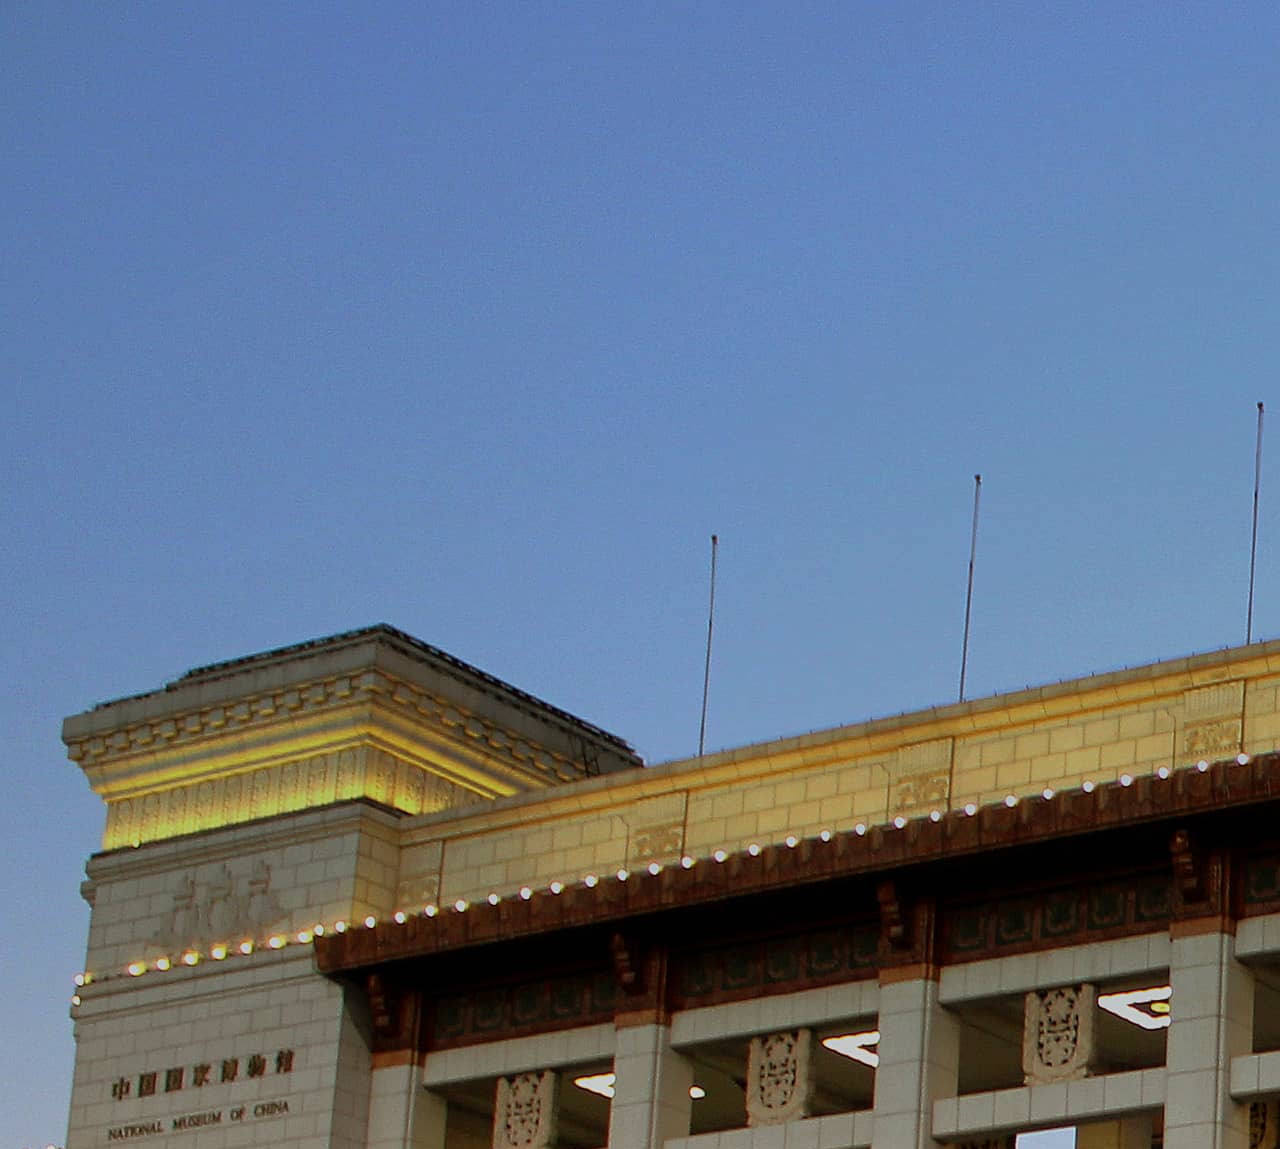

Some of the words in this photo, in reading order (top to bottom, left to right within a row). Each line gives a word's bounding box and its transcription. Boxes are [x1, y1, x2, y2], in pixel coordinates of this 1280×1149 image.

[108, 1121, 163, 1140] NATIONAL
[173, 1111, 222, 1130] MUSEUM
[230, 1105, 246, 1122] OF
[254, 1101, 289, 1118] CHINA
